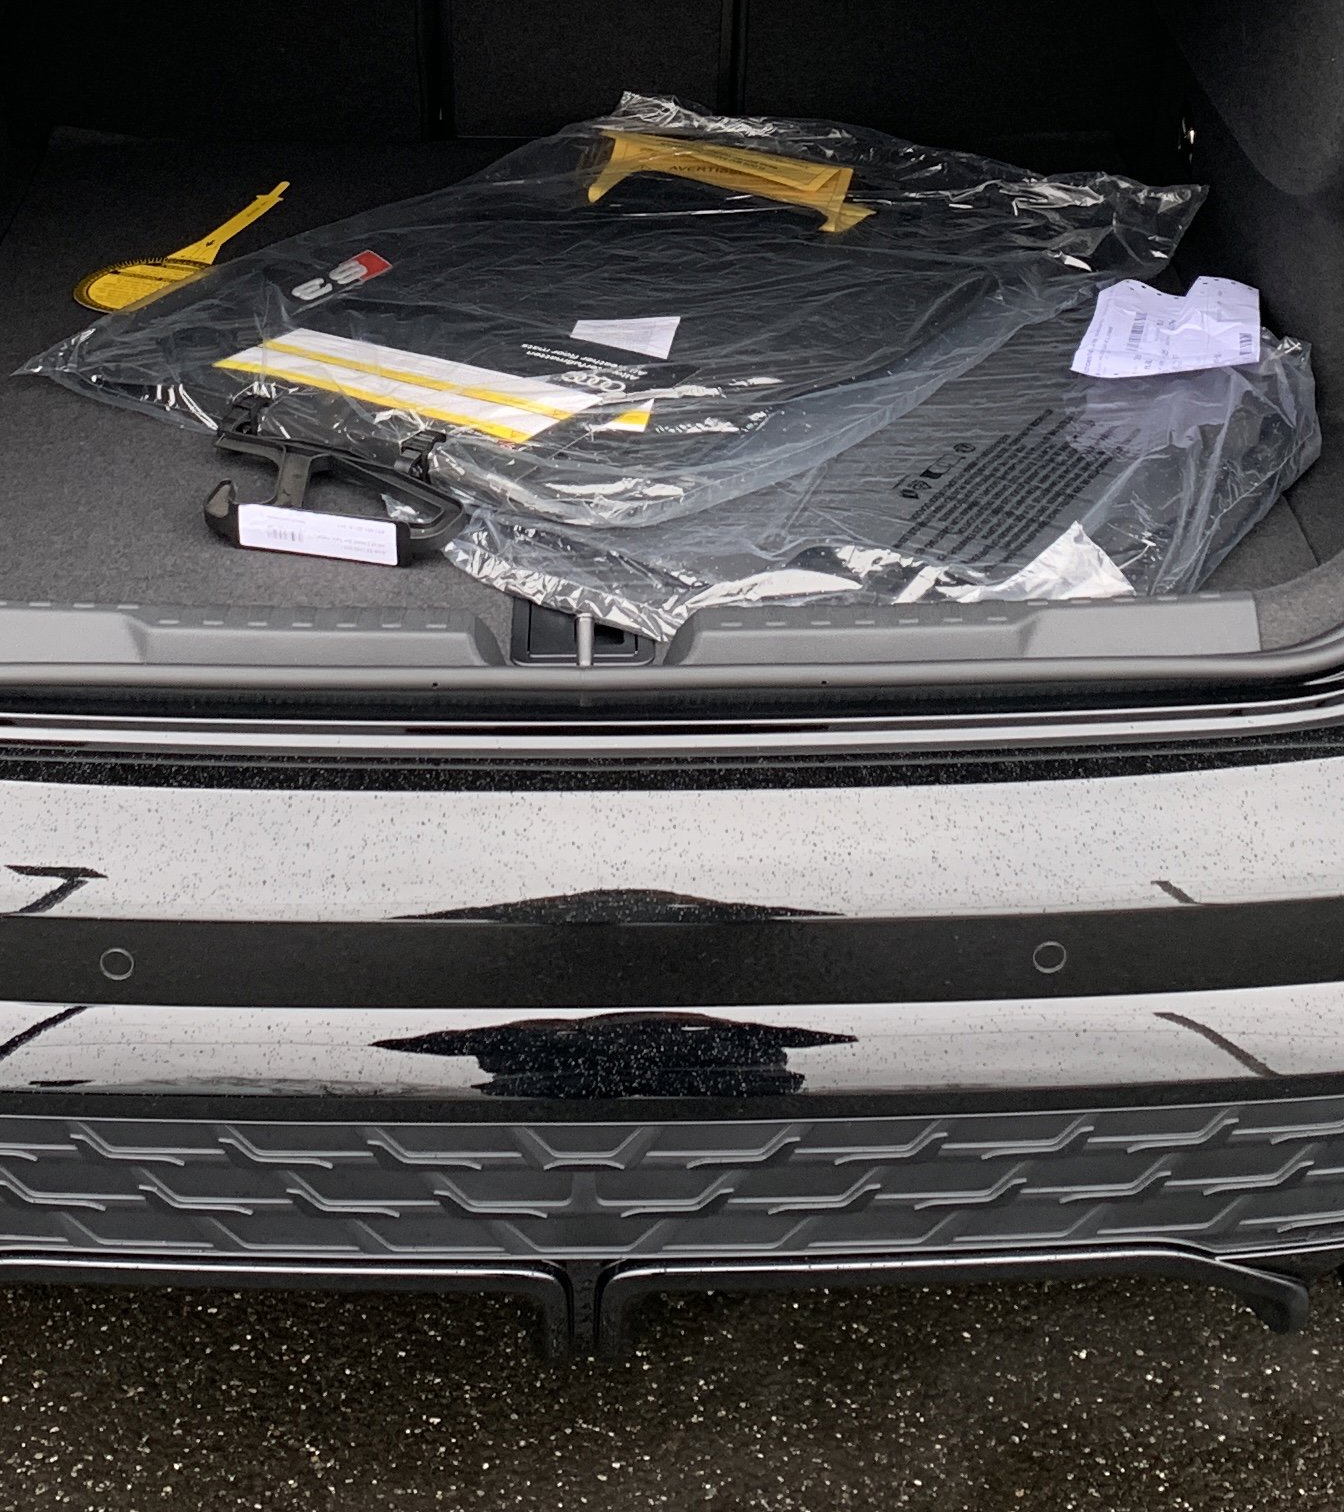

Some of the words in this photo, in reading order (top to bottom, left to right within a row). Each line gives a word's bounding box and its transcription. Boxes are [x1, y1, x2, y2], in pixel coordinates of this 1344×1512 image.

[291, 259, 369, 301] S3
[520, 342, 551, 353] mats
[551, 350, 580, 359] floor
